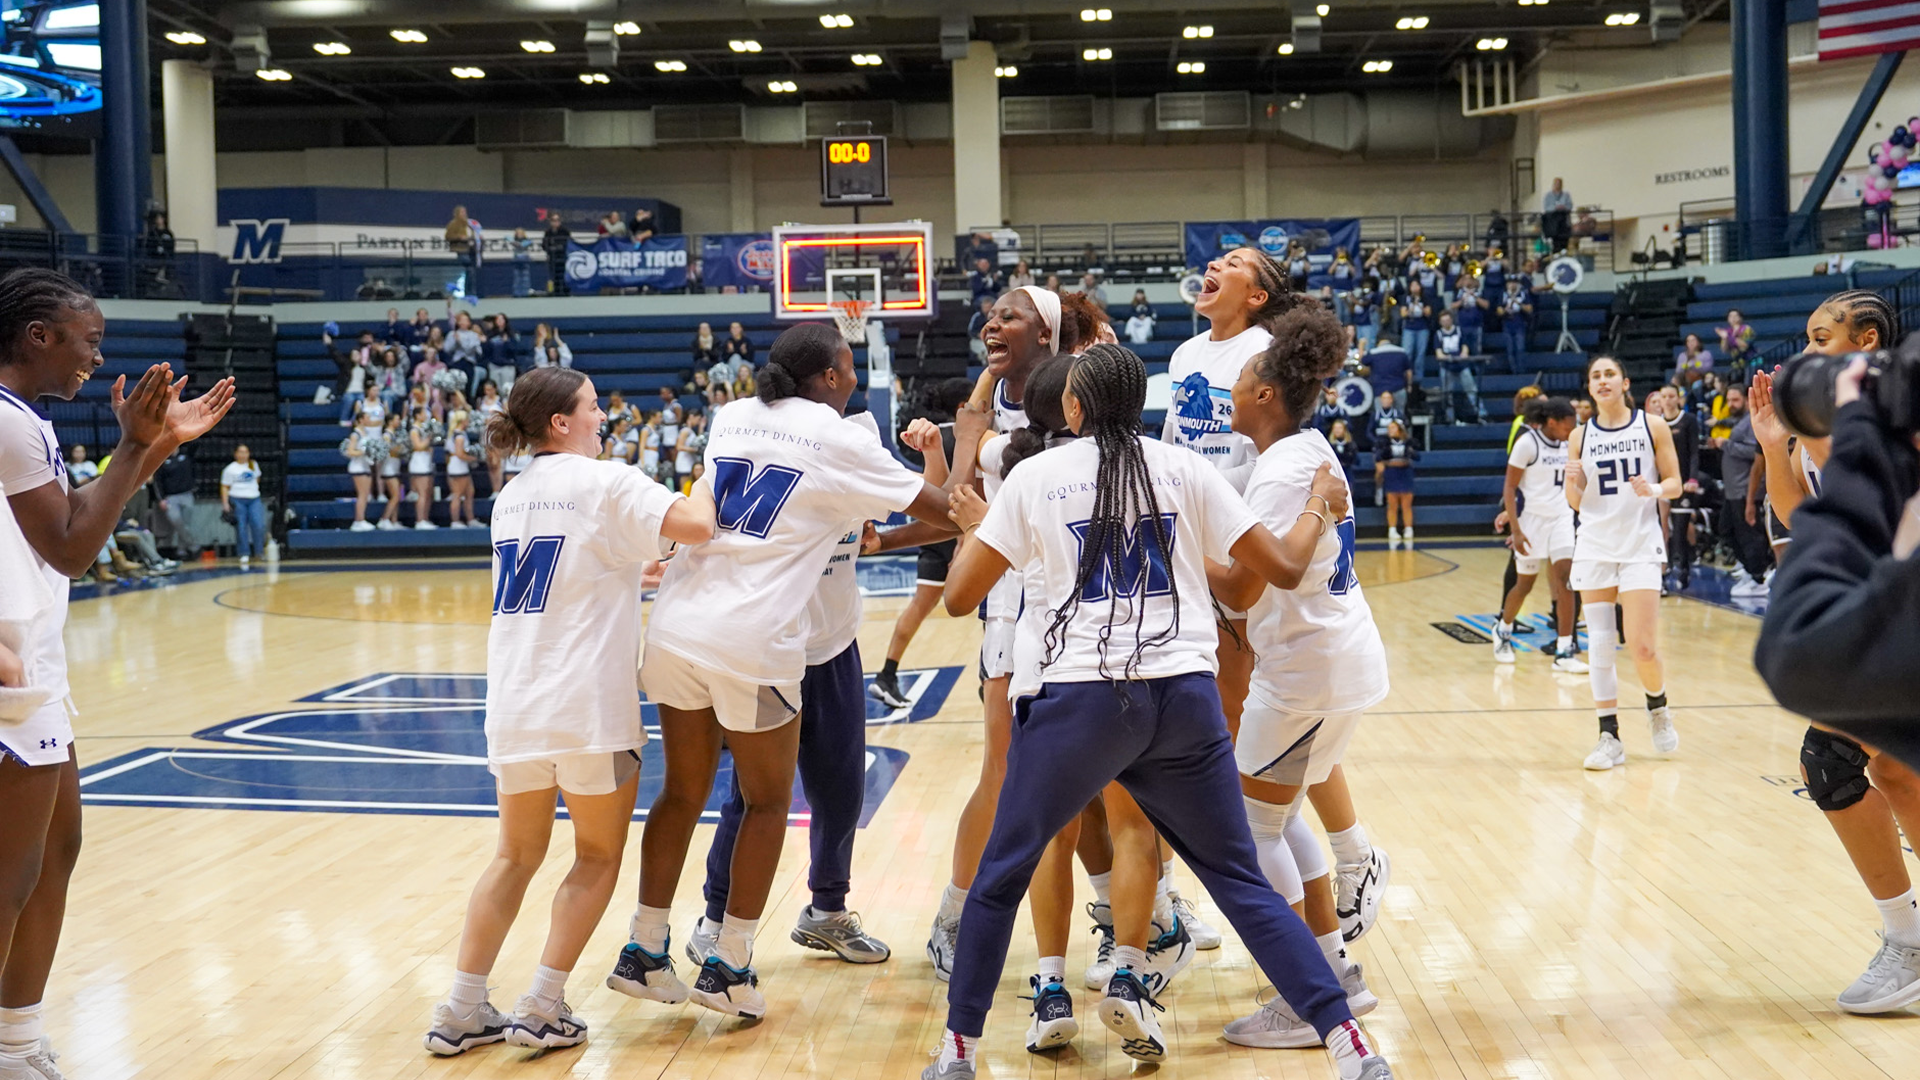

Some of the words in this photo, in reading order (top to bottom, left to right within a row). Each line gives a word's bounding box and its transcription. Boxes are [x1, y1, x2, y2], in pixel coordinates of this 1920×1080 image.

[1655, 165, 1730, 185] RESTROOMS
[228, 218, 290, 264] M
[598, 252, 641, 268] SURF
[644, 250, 687, 267] TACO
[1218, 404, 1233, 416] 26
[773, 431, 822, 451] DINING
[1202, 445, 1231, 455] WOMEN
[1590, 439, 1645, 456] MONMOUTH
[1596, 457, 1641, 496] 24
[529, 501, 575, 511] DINING
[712, 456, 804, 539] M
[1066, 512, 1178, 602] M
[492, 535, 566, 616] M
